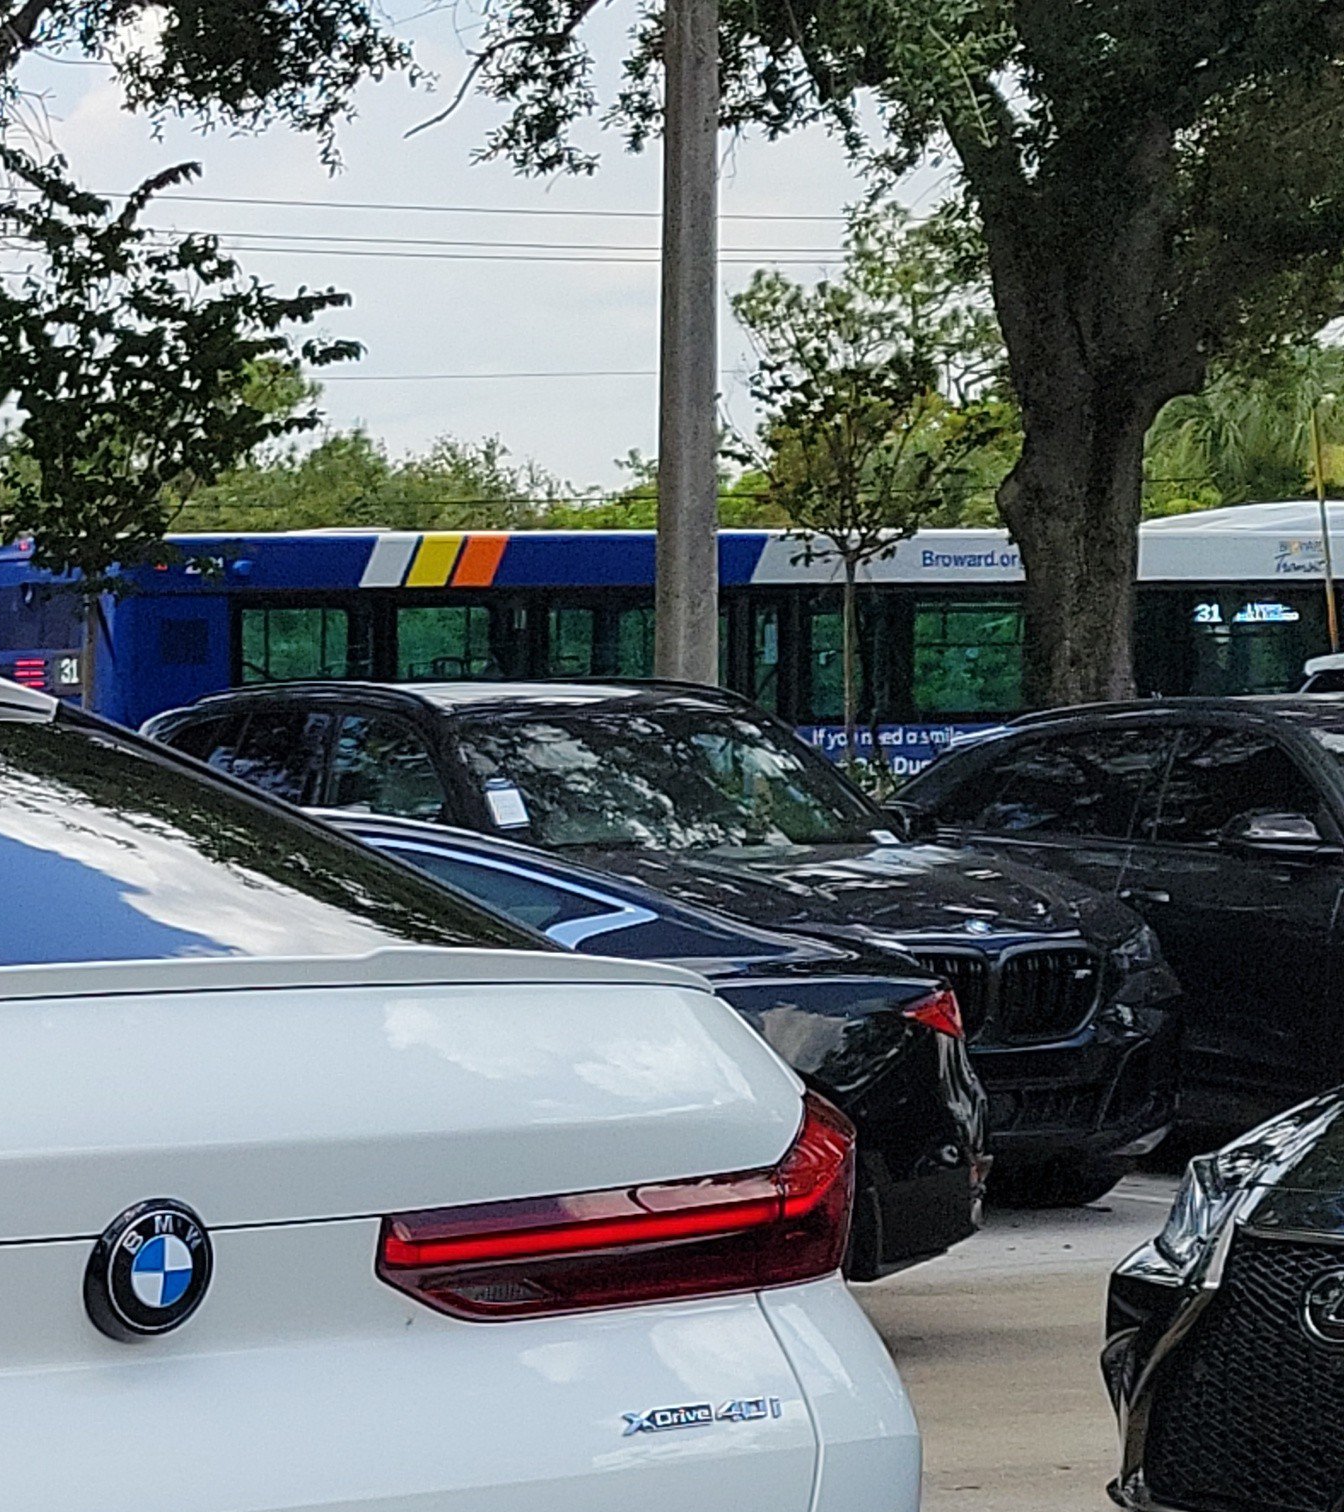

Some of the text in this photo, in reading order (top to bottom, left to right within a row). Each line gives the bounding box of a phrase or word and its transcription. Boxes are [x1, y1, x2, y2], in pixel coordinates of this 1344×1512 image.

[922, 549, 1019, 568] Broward.or
[1193, 603, 1223, 622] 31
[60, 657, 80, 684] 31
[812, 728, 826, 746] If
[122, 1214, 202, 1255] BMW
